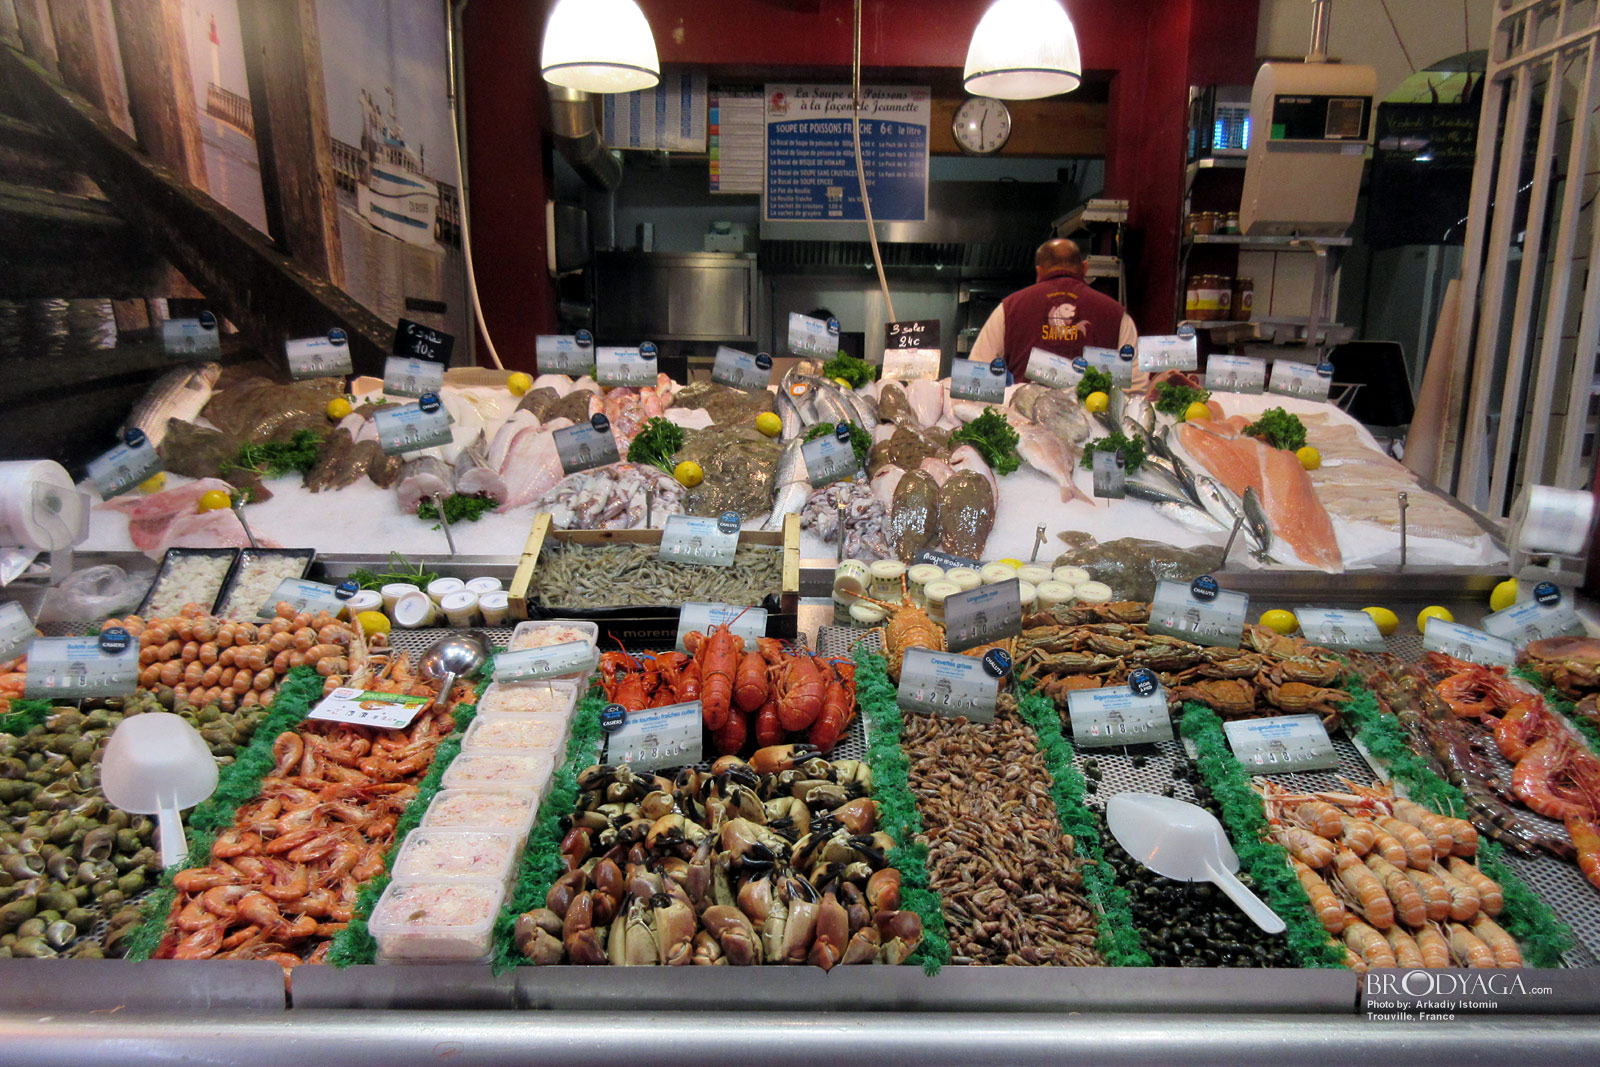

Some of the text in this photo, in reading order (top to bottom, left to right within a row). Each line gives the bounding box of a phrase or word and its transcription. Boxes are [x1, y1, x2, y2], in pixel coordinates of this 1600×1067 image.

[795, 88, 808, 98] La
[811, 88, 844, 100] Soupe
[864, 88, 908, 99] Poissons
[872, 102, 918, 114] Jeannette
[776, 124, 798, 134] SOUPE
[800, 124, 808, 134] DE
[810, 124, 842, 134] POISSONS
[890, 322, 925, 335] 3 soles
[985, 656, 1003, 675] CHALUTS
